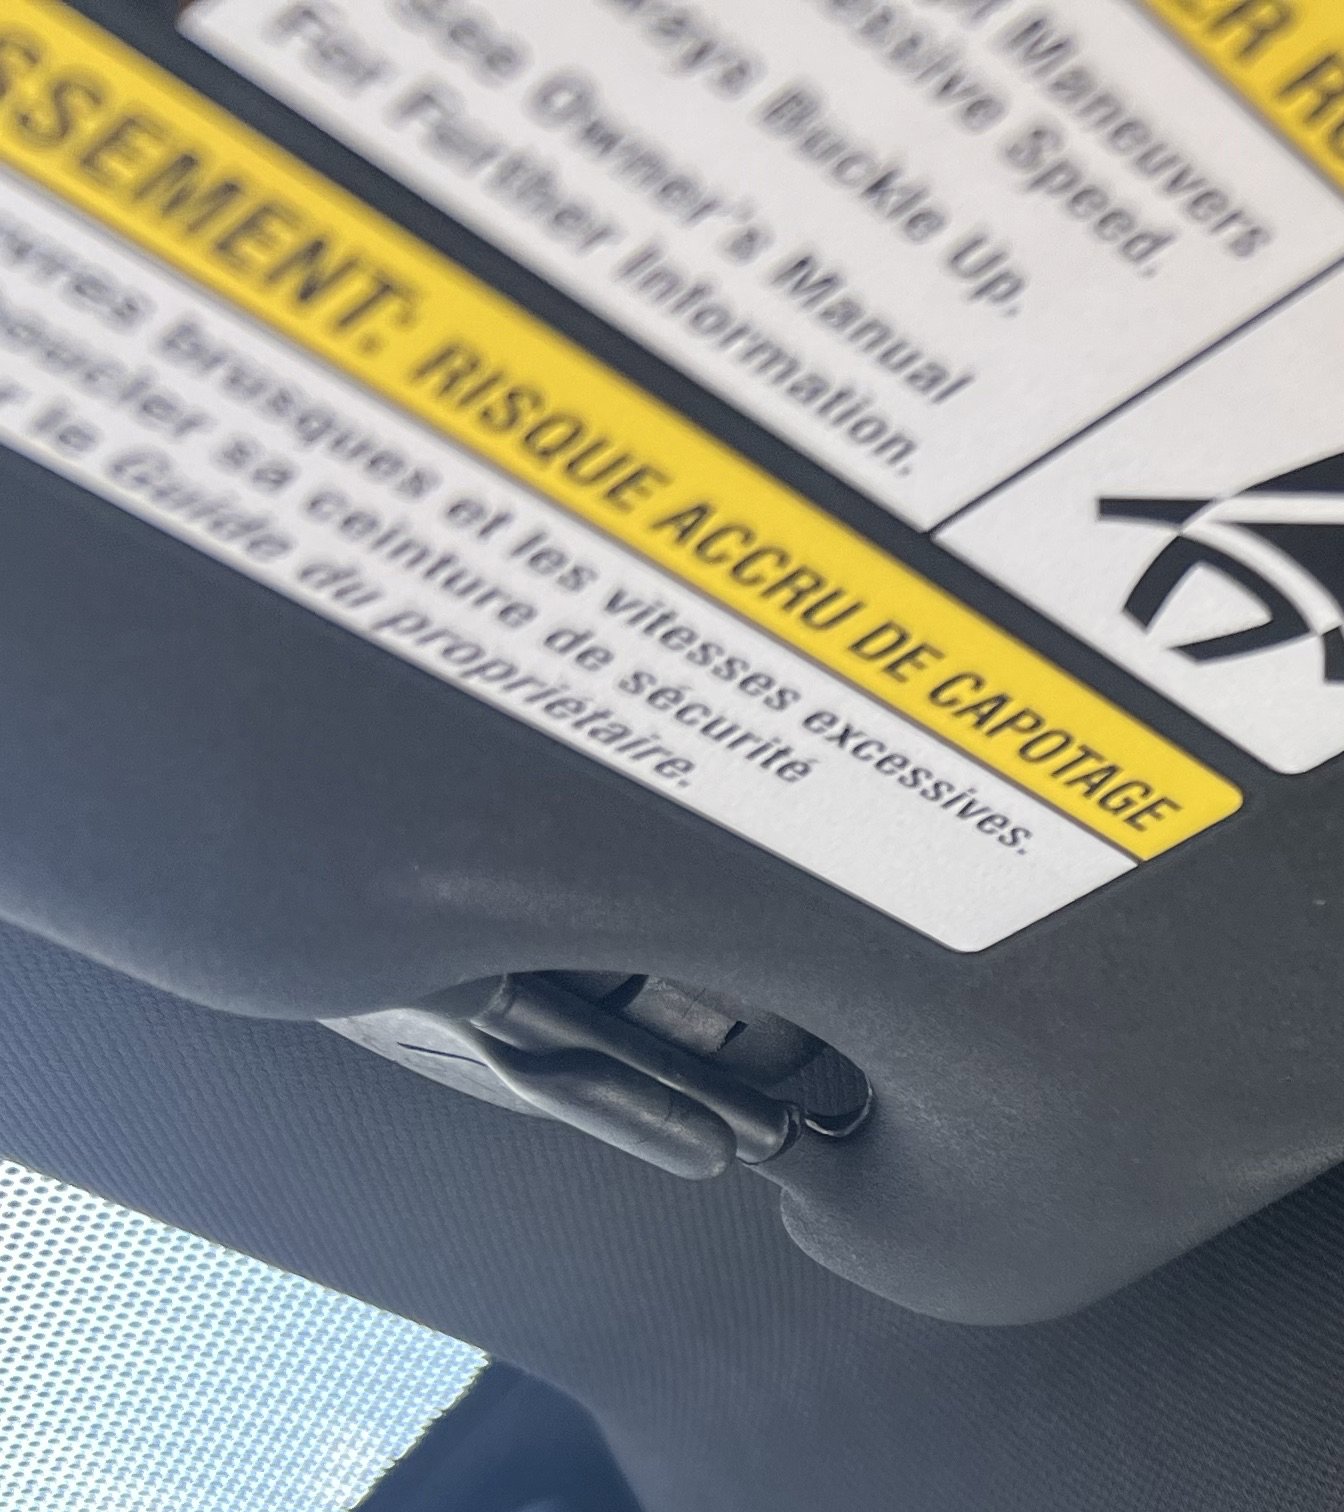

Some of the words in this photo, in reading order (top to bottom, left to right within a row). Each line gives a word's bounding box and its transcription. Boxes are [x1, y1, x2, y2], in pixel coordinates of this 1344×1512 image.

[266, 2, 396, 94] For
[385, 74, 619, 255] Further
[614, 241, 918, 476] Information.
[525, 68, 772, 263] Owner's
[769, 253, 975, 405] Manual
[758, 86, 948, 243] Buckle
[945, 229, 1028, 319] Up.
[1000, 14, 1273, 259] Maneuvers
[1001, 121, 1177, 279] Speed.
[28, 402, 99, 456] le
[104, 445, 294, 560] Guide
[297, 560, 386, 610] du
[370, 609, 696, 788] propriétaire.
[157, 310, 441, 498] brusques
[444, 497, 514, 540] et
[508, 530, 598, 593] les
[603, 587, 802, 712] vitesses
[801, 708, 1033, 856] excessives.
[212, 431, 296, 492] sa
[303, 486, 538, 630] ceinture
[543, 626, 614, 672] de
[618, 668, 814, 784] sécurité
[410, 340, 672, 514] RISQUE
[649, 500, 866, 632] ACCRU
[847, 619, 945, 685] DE
[927, 670, 1184, 832] CAPOTAGE
